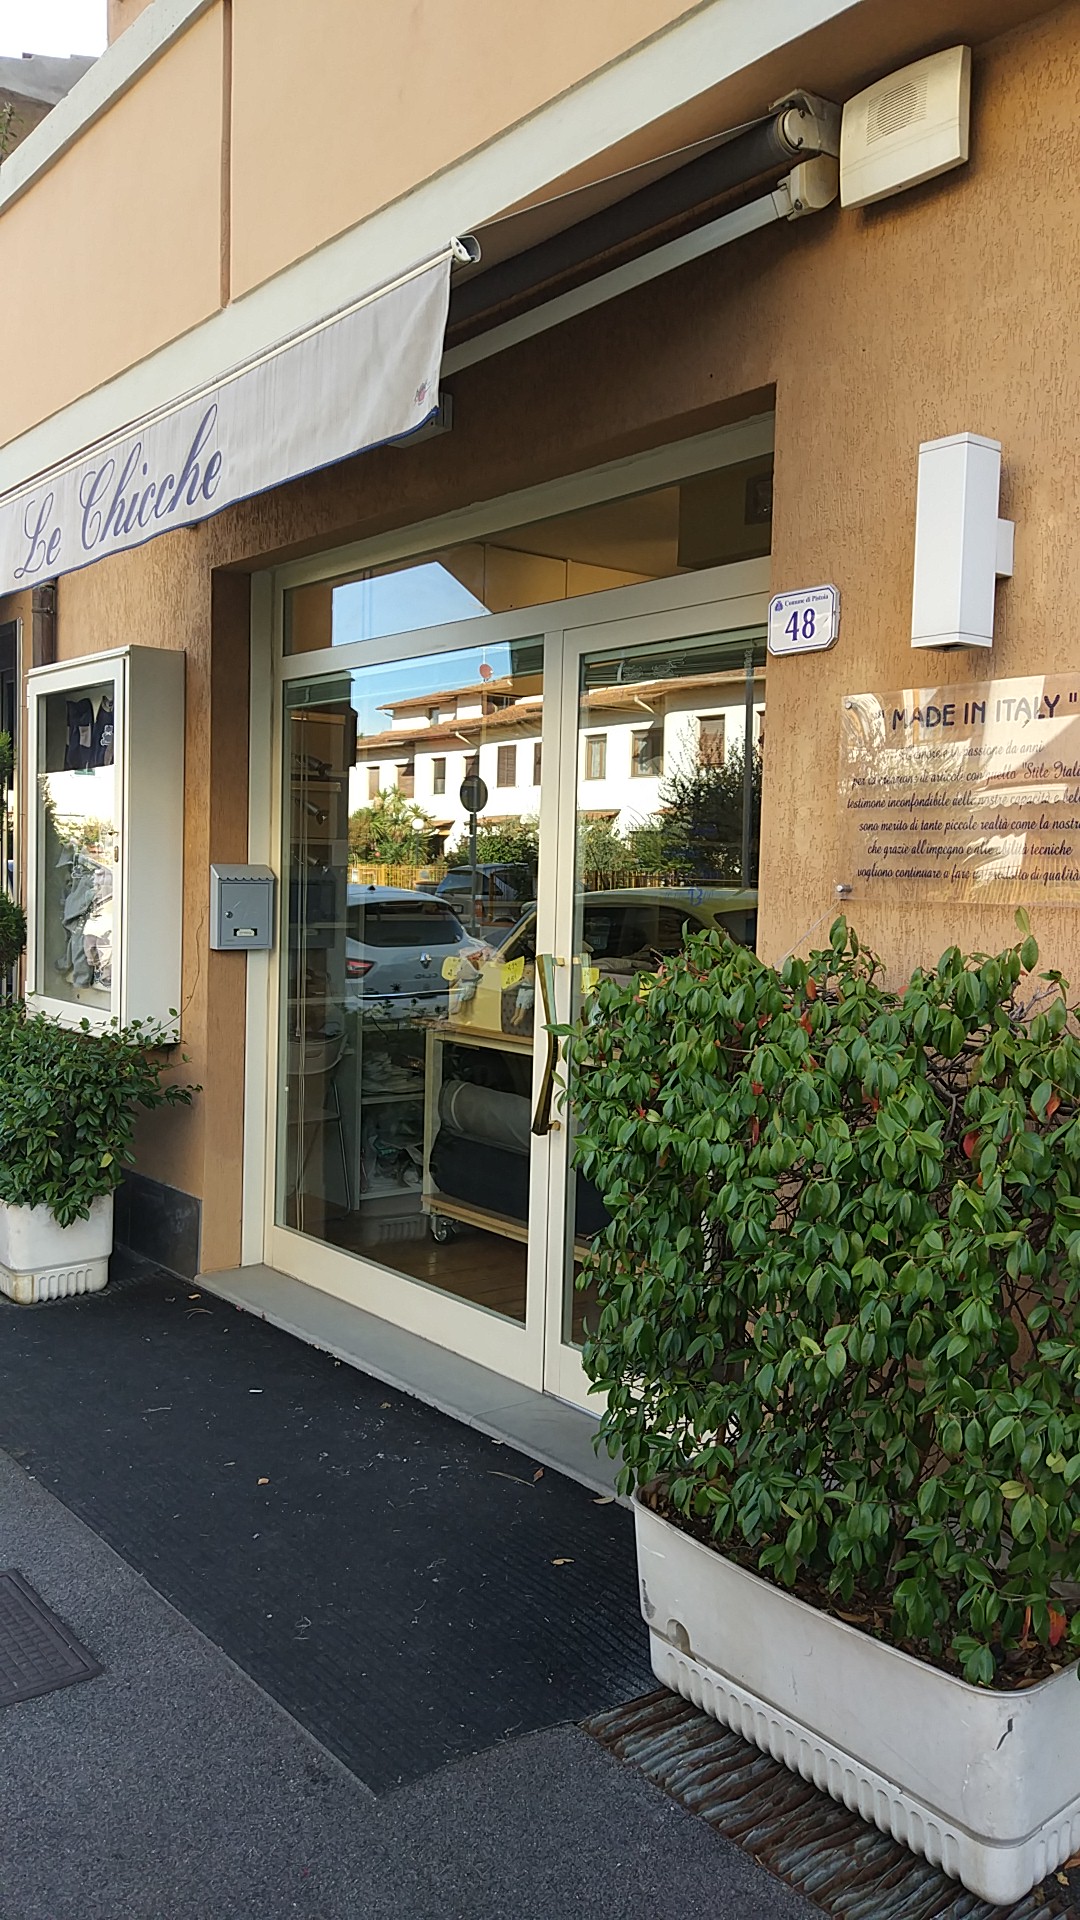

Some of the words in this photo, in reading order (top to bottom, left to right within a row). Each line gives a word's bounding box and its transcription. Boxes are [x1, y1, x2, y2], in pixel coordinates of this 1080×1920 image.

[13, 492, 61, 579] Le
[79, 402, 223, 550] Chicche
[785, 608, 815, 641] 48
[892, 704, 956, 730] MADE
[964, 701, 986, 726] IN
[995, 694, 1061, 723] ITALY
[1005, 740, 1018, 755] da
[1020, 740, 1046, 753] anni
[966, 770, 982, 781] con
[887, 791, 950, 812] inconfondibile
[859, 822, 879, 832] sono
[880, 819, 908, 831] merito
[909, 817, 919, 831] di
[920, 819, 943, 831] tante
[942, 815, 979, 835] piccole
[980, 814, 1009, 830] realtà
[1010, 820, 1037, 831] come
[1039, 814, 1050, 830] la
[867, 840, 882, 854] che
[883, 844, 910, 859] grazie
[1030, 839, 1073, 856] tecniche
[857, 862, 893, 882] vogliono
[895, 867, 942, 879] continuare
[943, 870, 949, 879] a
[950, 863, 970, 884] fare
[1030, 866, 1041, 880] di
